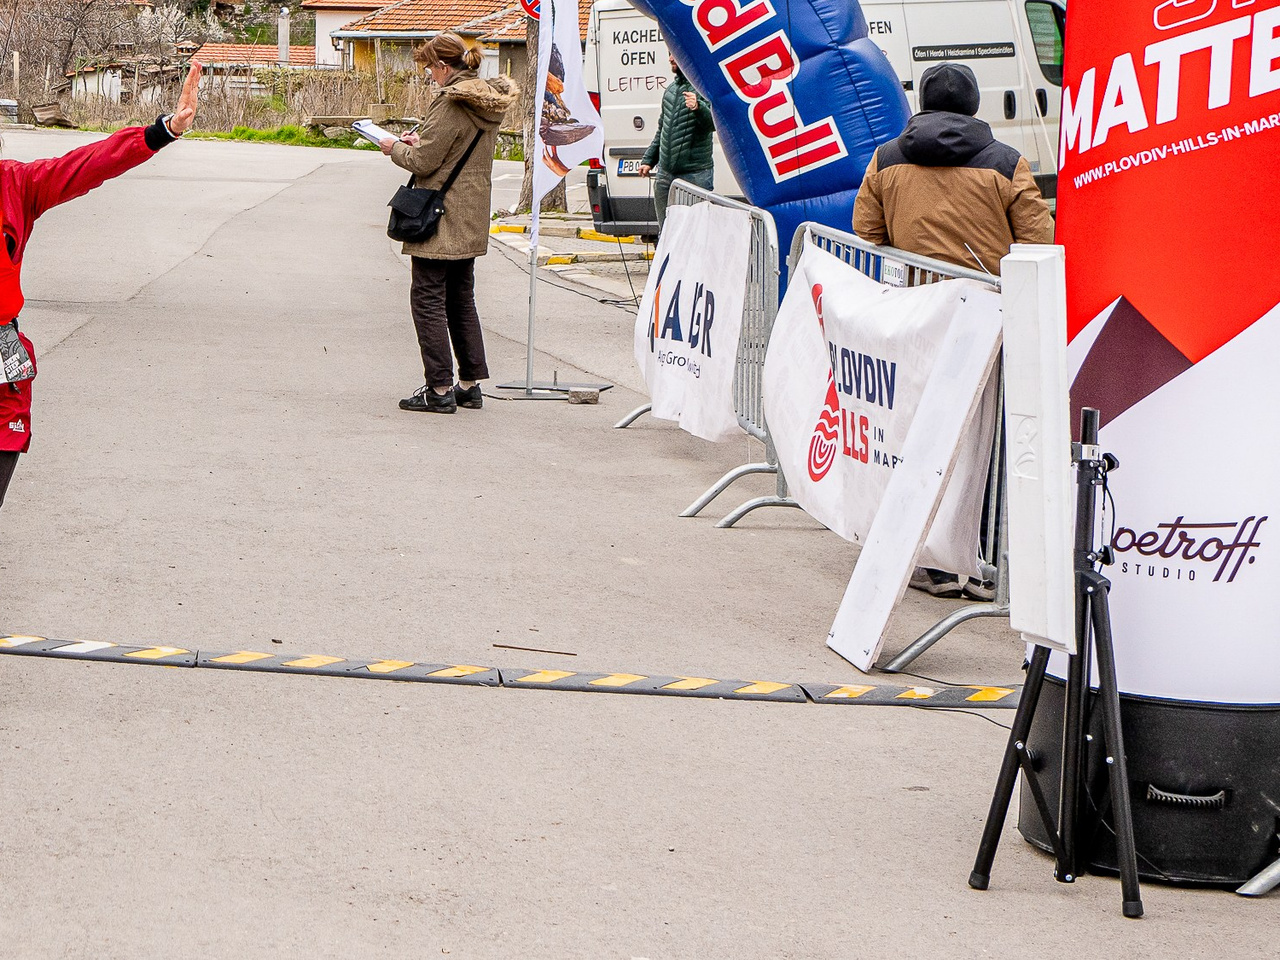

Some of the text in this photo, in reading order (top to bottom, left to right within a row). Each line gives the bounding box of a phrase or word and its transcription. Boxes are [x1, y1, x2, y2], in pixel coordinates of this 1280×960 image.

[869, 21, 893, 34] FEN
[621, 49, 656, 66] ÖFEN
[607, 75, 668, 92] LEITER
[721, 31, 845, 180] Bull
[1073, 112, 1280, 190] WWW.PLOVDIV-HILLS-IN-MAR
[841, 407, 869, 465] LLS
[873, 426, 885, 443] IN
[1121, 561, 1197, 582] STUDIO
